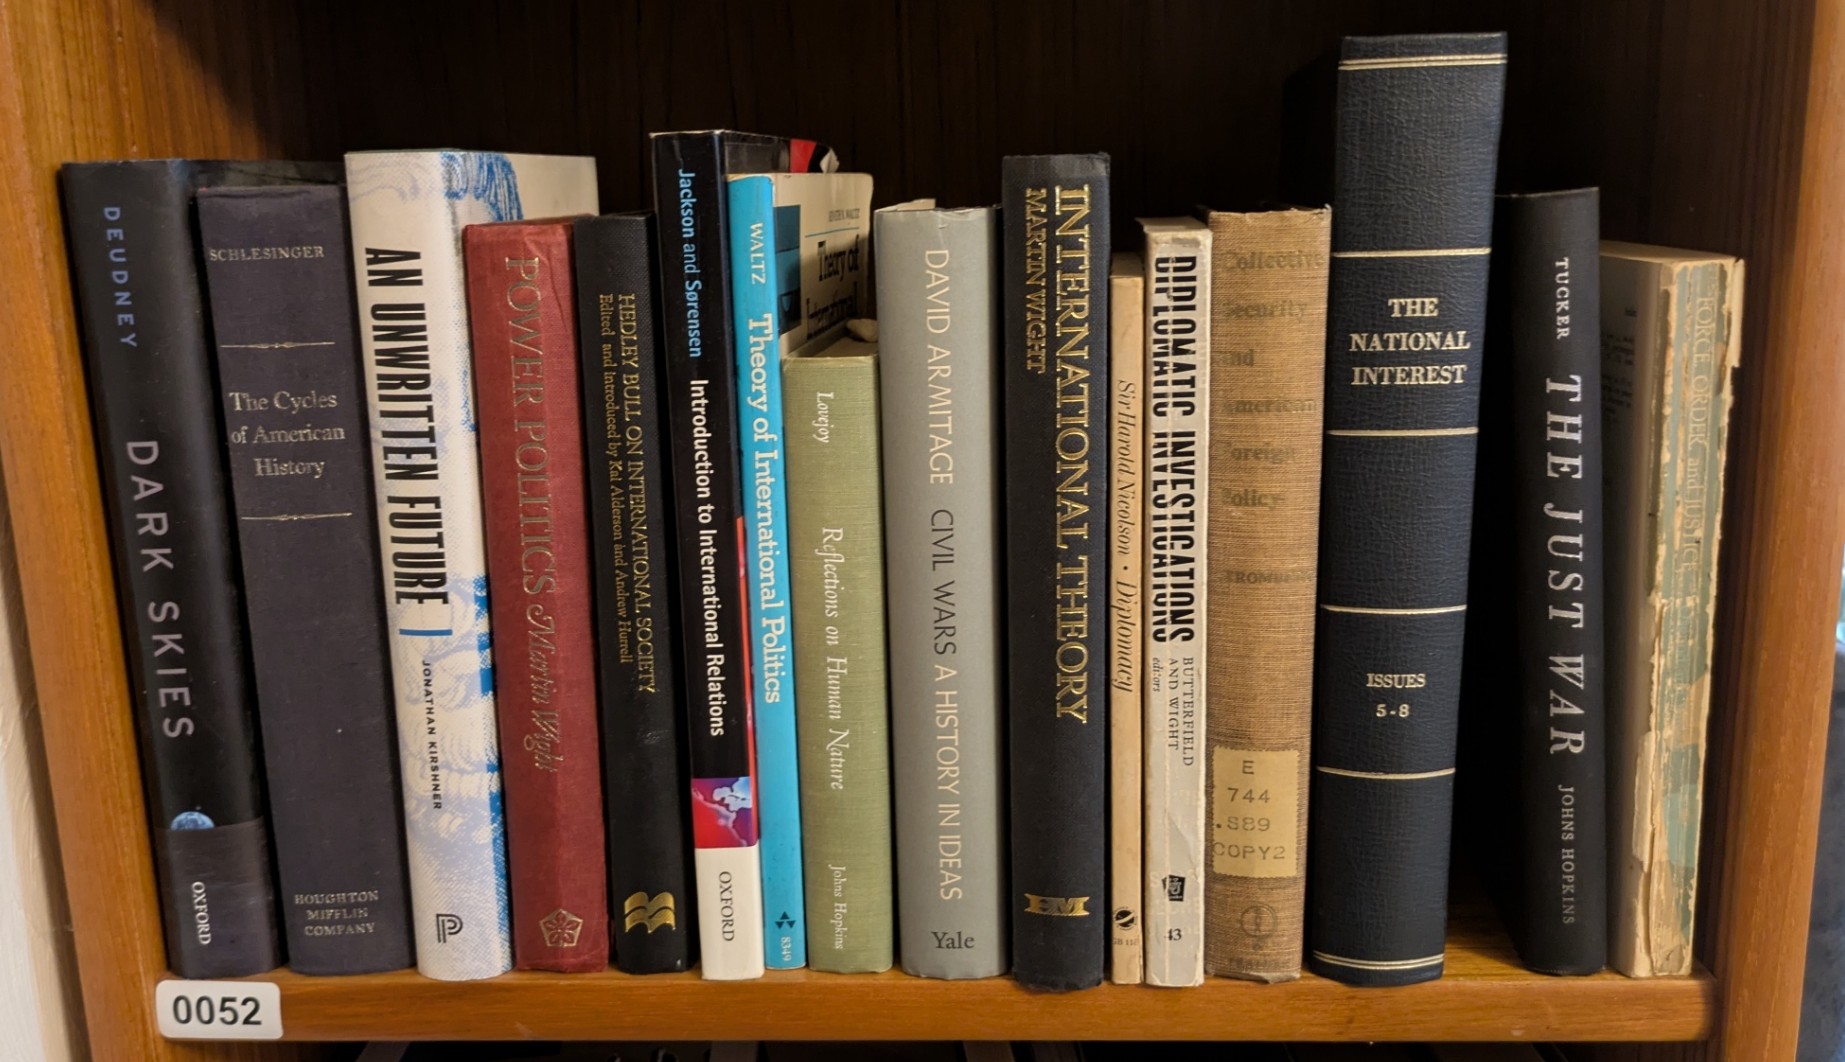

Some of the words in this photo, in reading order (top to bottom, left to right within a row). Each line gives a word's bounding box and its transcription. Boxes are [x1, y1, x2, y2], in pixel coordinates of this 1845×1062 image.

[678, 168, 698, 239] Jackson
[208, 245, 326, 263] SCHLESINGER
[364, 247, 424, 287] AN
[682, 242, 702, 274] and
[749, 222, 767, 285] WALTZ
[1025, 187, 1048, 286] MARTIN
[103, 206, 138, 349] DEUDNEY
[924, 249, 951, 335] DAVID
[1387, 296, 1439, 318] THE
[1554, 256, 1571, 341] TUCKER
[504, 256, 547, 408] POWER
[600, 293, 616, 336] Edited
[618, 293, 640, 368] HEDLEY
[684, 280, 703, 358] Sørensen
[1025, 288, 1048, 375] WIGHT
[1152, 255, 1197, 418] DIPLOMATIC
[1348, 330, 1472, 352] NATIONAL
[602, 343, 618, 368] and
[746, 312, 773, 412] Theory
[1055, 183, 1091, 550] INTERNATIONAL
[1350, 364, 1468, 385] INTEREST
[229, 391, 268, 412] The
[273, 390, 339, 416] Cycles
[370, 302, 440, 482] UNWRITTEN
[604, 371, 622, 439] introduced
[622, 373, 643, 422] BULL
[812, 390, 834, 444] Lovejoy
[926, 344, 954, 485] ARMITAGE
[1117, 378, 1137, 410] Sir
[230, 425, 250, 446] of
[252, 423, 347, 445] American
[605, 441, 622, 457] by
[625, 425, 645, 456] ON
[689, 379, 716, 498] Introduction
[752, 417, 779, 442] of
[1116, 410, 1138, 476] Harold
[1545, 373, 1583, 480] THE
[253, 457, 326, 479] History
[609, 459, 623, 482] Kai
[1685, 457, 1706, 491] and
[126, 440, 175, 573] DARK
[514, 419, 557, 596] POLITICS
[610, 484, 626, 541] Alderson
[627, 460, 652, 614] INTERNATIONAL
[696, 503, 716, 524] to
[753, 450, 785, 610] International
[1115, 476, 1137, 556] Nicolson
[1151, 430, 1197, 643] INVESTIGATIONS
[1680, 497, 1705, 573] JUSTICE
[387, 495, 449, 606] FUTURE
[614, 543, 628, 568] and
[815, 526, 845, 618] Reflections
[930, 508, 955, 573] CIVIL
[1543, 502, 1585, 630] JUST
[616, 569, 631, 619] Andrew
[699, 529, 724, 649] International
[932, 579, 957, 657] WARS
[525, 603, 557, 705] Martin
[618, 620, 634, 664] Hurrell
[636, 617, 656, 693] SOCIETY
[761, 615, 787, 704] Politics
[824, 625, 840, 646] on
[1054, 555, 1091, 724] THEORY
[1110, 579, 1138, 693] Diplomacy
[147, 600, 195, 738] SKIES
[422, 659, 438, 736] JONATHAN
[705, 653, 727, 738] Relations
[826, 655, 848, 720] Human
[934, 664, 958, 683] A
[1168, 657, 1180, 692] AND
[1365, 672, 1427, 689] ISSUES
[1167, 696, 1180, 751] WIGHT
[1181, 656, 1195, 767] BUTTERFIELD
[1547, 652, 1586, 755] WAR
[523, 708, 563, 773] Wight
[825, 727, 850, 791] Nature
[934, 690, 961, 796] HISTORY
[1240, 759, 1256, 775] E
[428, 740, 443, 811] KIRSHNER
[1226, 787, 1271, 804] 744
[937, 802, 961, 827] IN
[1215, 816, 1271, 833] .S89
[1557, 784, 1575, 841] JOHNS
[828, 863, 846, 898] Johns
[938, 834, 964, 901] IDEAS
[1212, 841, 1286, 861] COPY2
[191, 880, 212, 946] OXFORD
[294, 889, 380, 906] HOUGHTON
[305, 906, 369, 921] MIFFLIN
[718, 870, 736, 943] OXFORD
[1560, 846, 1576, 926] HOPKINS
[304, 921, 376, 937] COMPANY
[834, 901, 848, 950] Hopkins
[930, 930, 976, 950] Yale
[171, 994, 263, 1027] 0052
